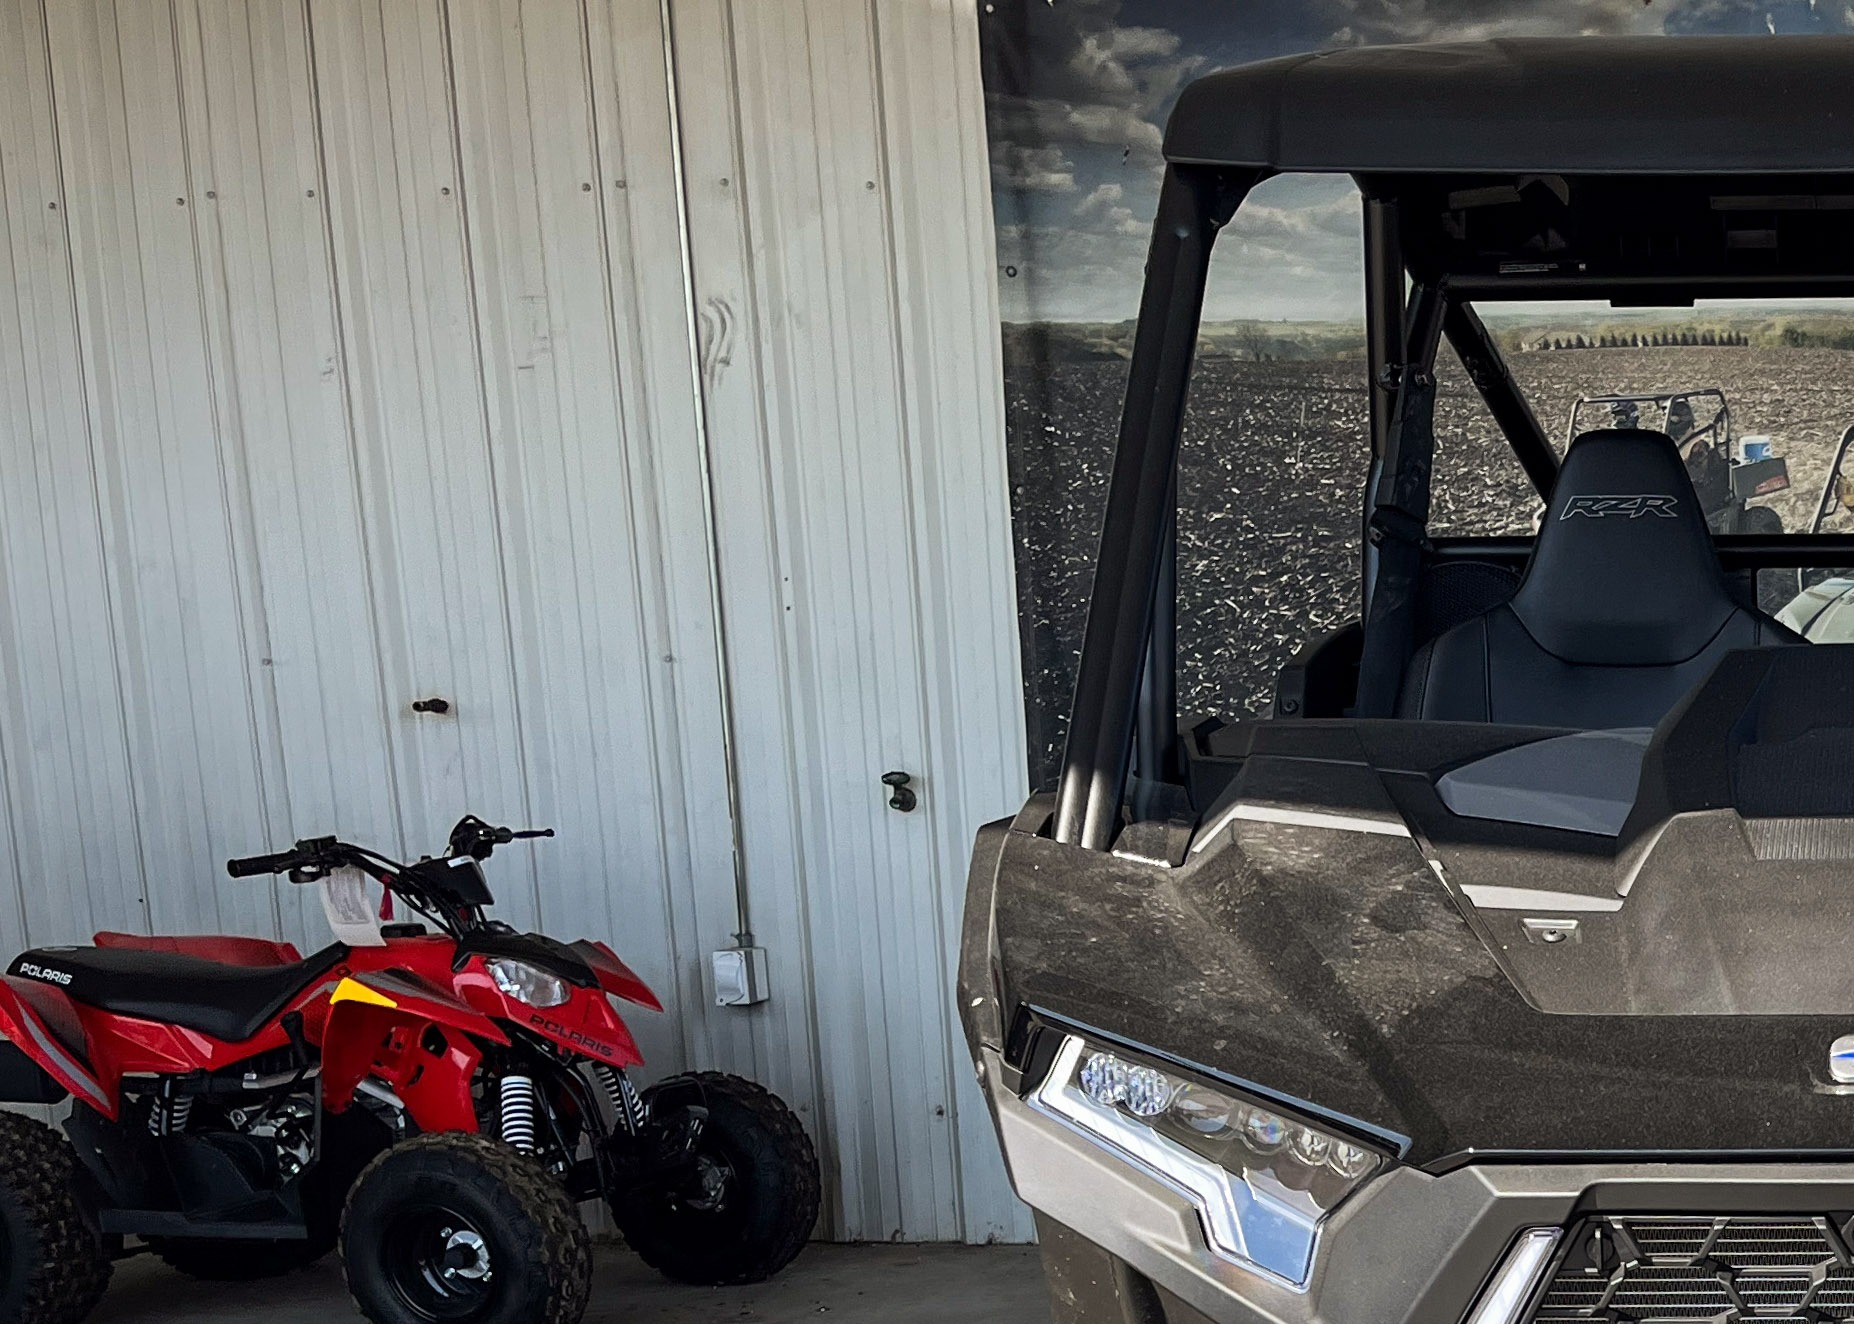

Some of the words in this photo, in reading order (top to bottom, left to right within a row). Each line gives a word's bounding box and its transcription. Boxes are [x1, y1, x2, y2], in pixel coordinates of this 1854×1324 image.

[1560, 495, 1678, 520] RZR
[20, 962, 73, 985] POLARIS
[529, 1014, 614, 1057] POLARIS
